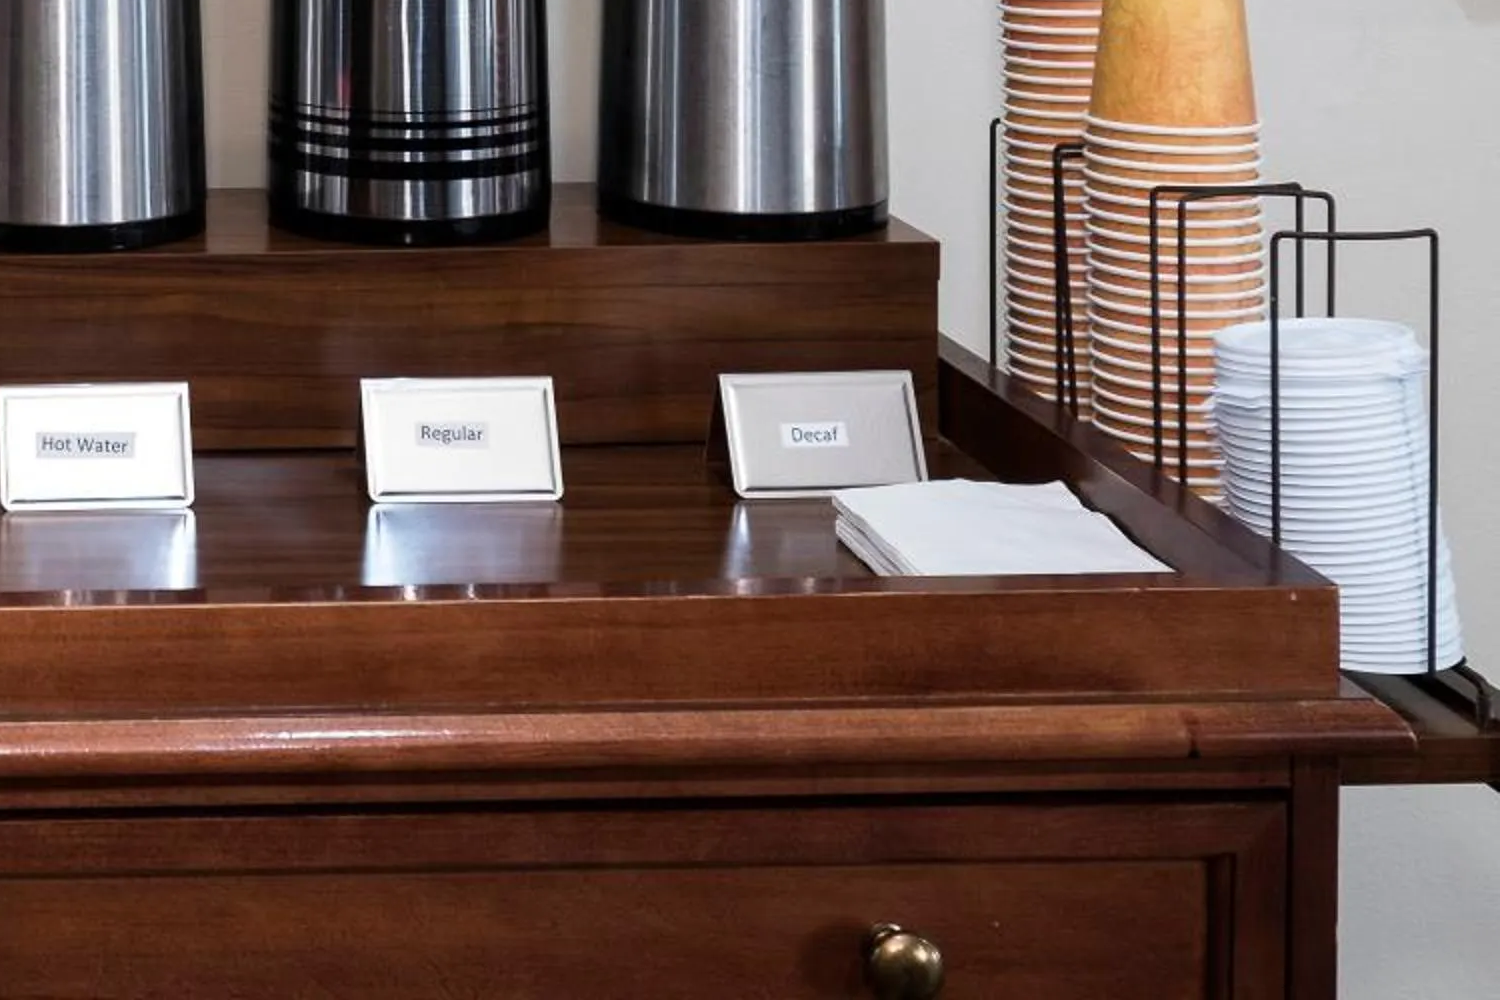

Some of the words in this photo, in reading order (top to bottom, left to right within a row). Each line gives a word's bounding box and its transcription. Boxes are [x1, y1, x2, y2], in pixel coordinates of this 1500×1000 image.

[420, 424, 484, 445] Regular
[791, 426, 838, 443] Decaf
[41, 436, 72, 452] Hot
[76, 436, 129, 454] Water
